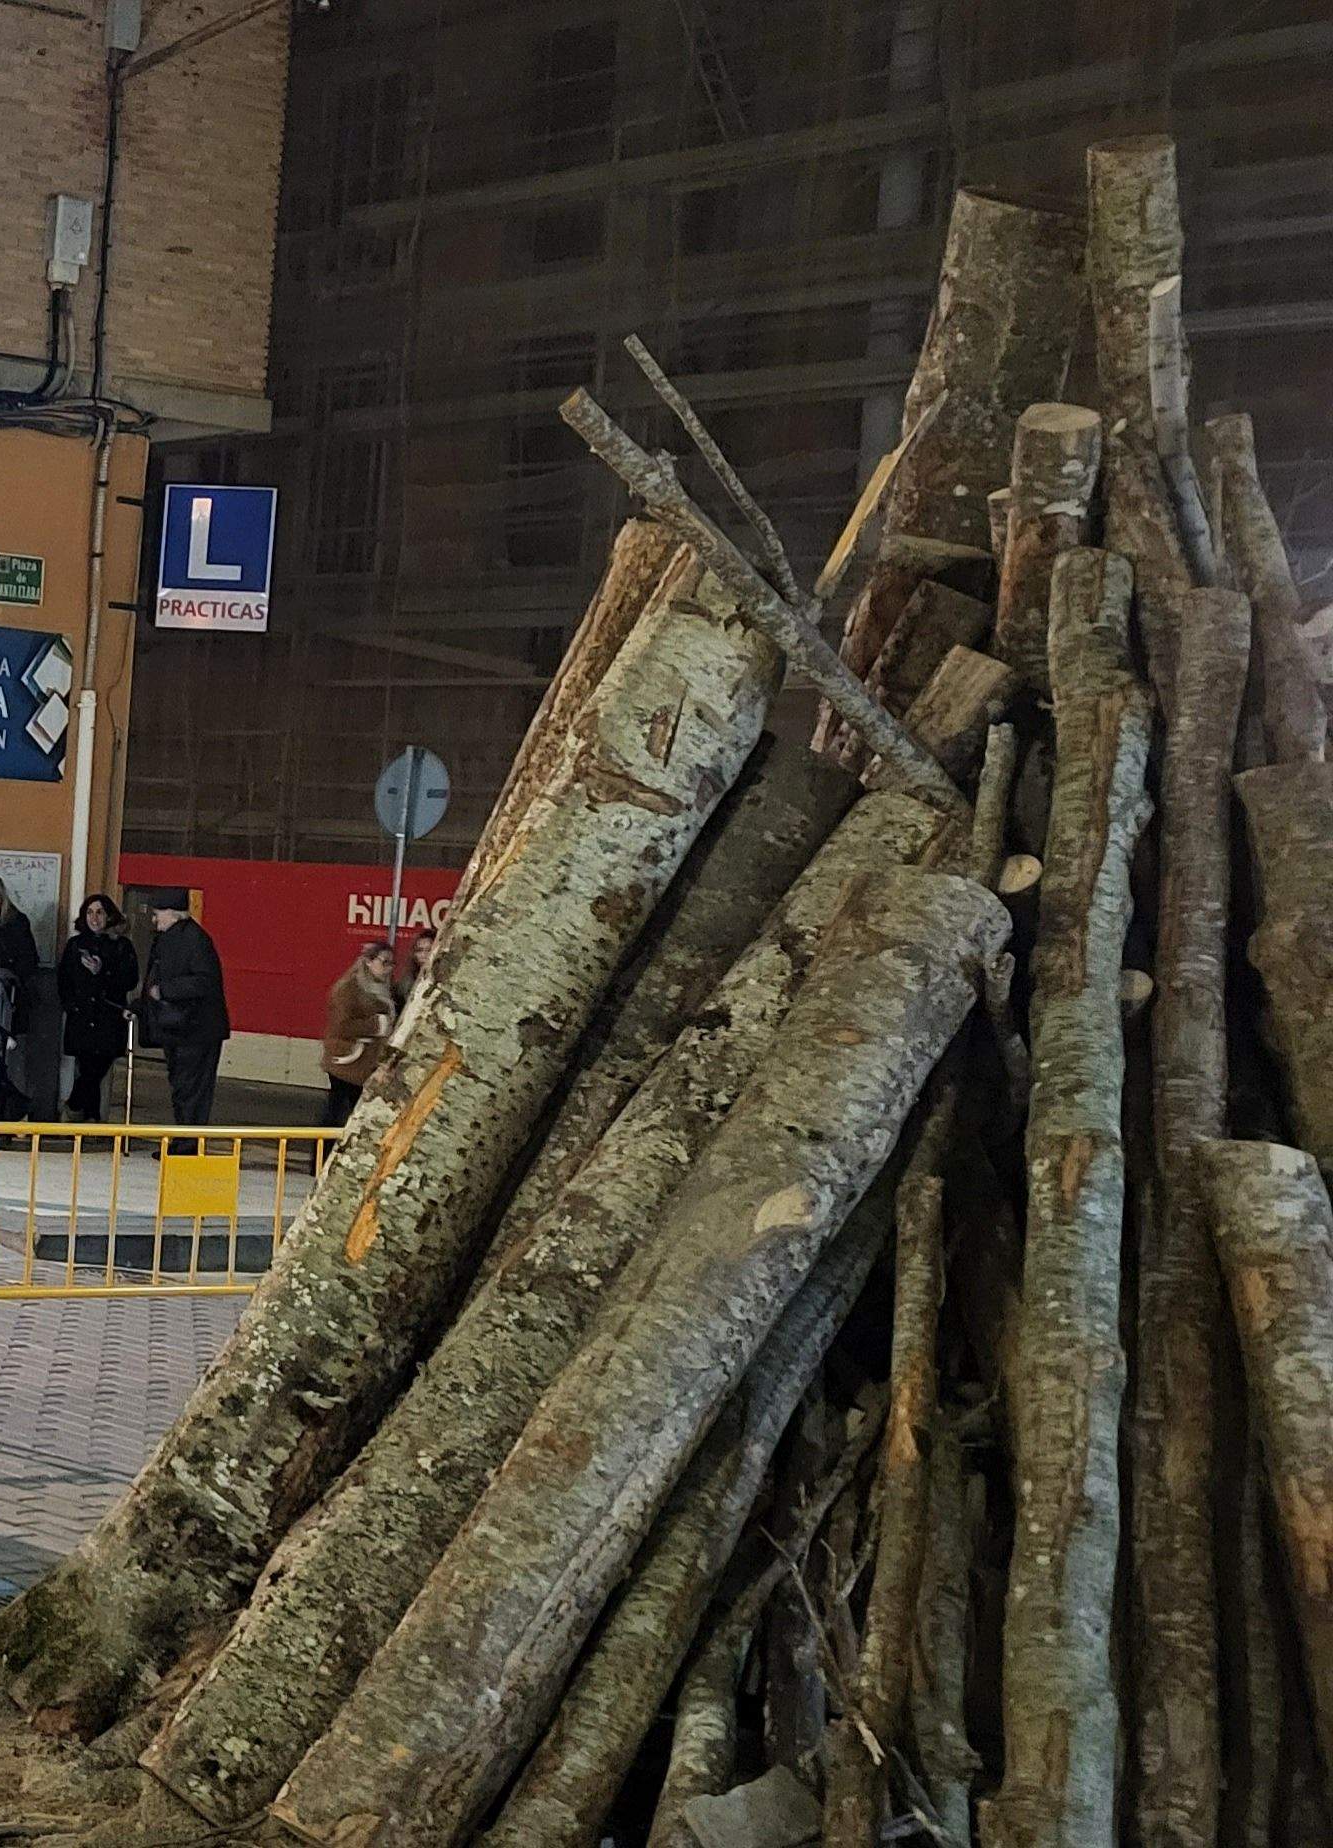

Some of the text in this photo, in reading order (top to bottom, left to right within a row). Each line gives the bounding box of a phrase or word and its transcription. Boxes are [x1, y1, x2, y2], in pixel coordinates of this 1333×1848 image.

[187, 497, 242, 581] L
[12, 558, 37, 571] Plaza
[16, 573, 27, 583] de
[159, 599, 266, 620] PRACTICAS
[347, 893, 453, 930] HINAC
